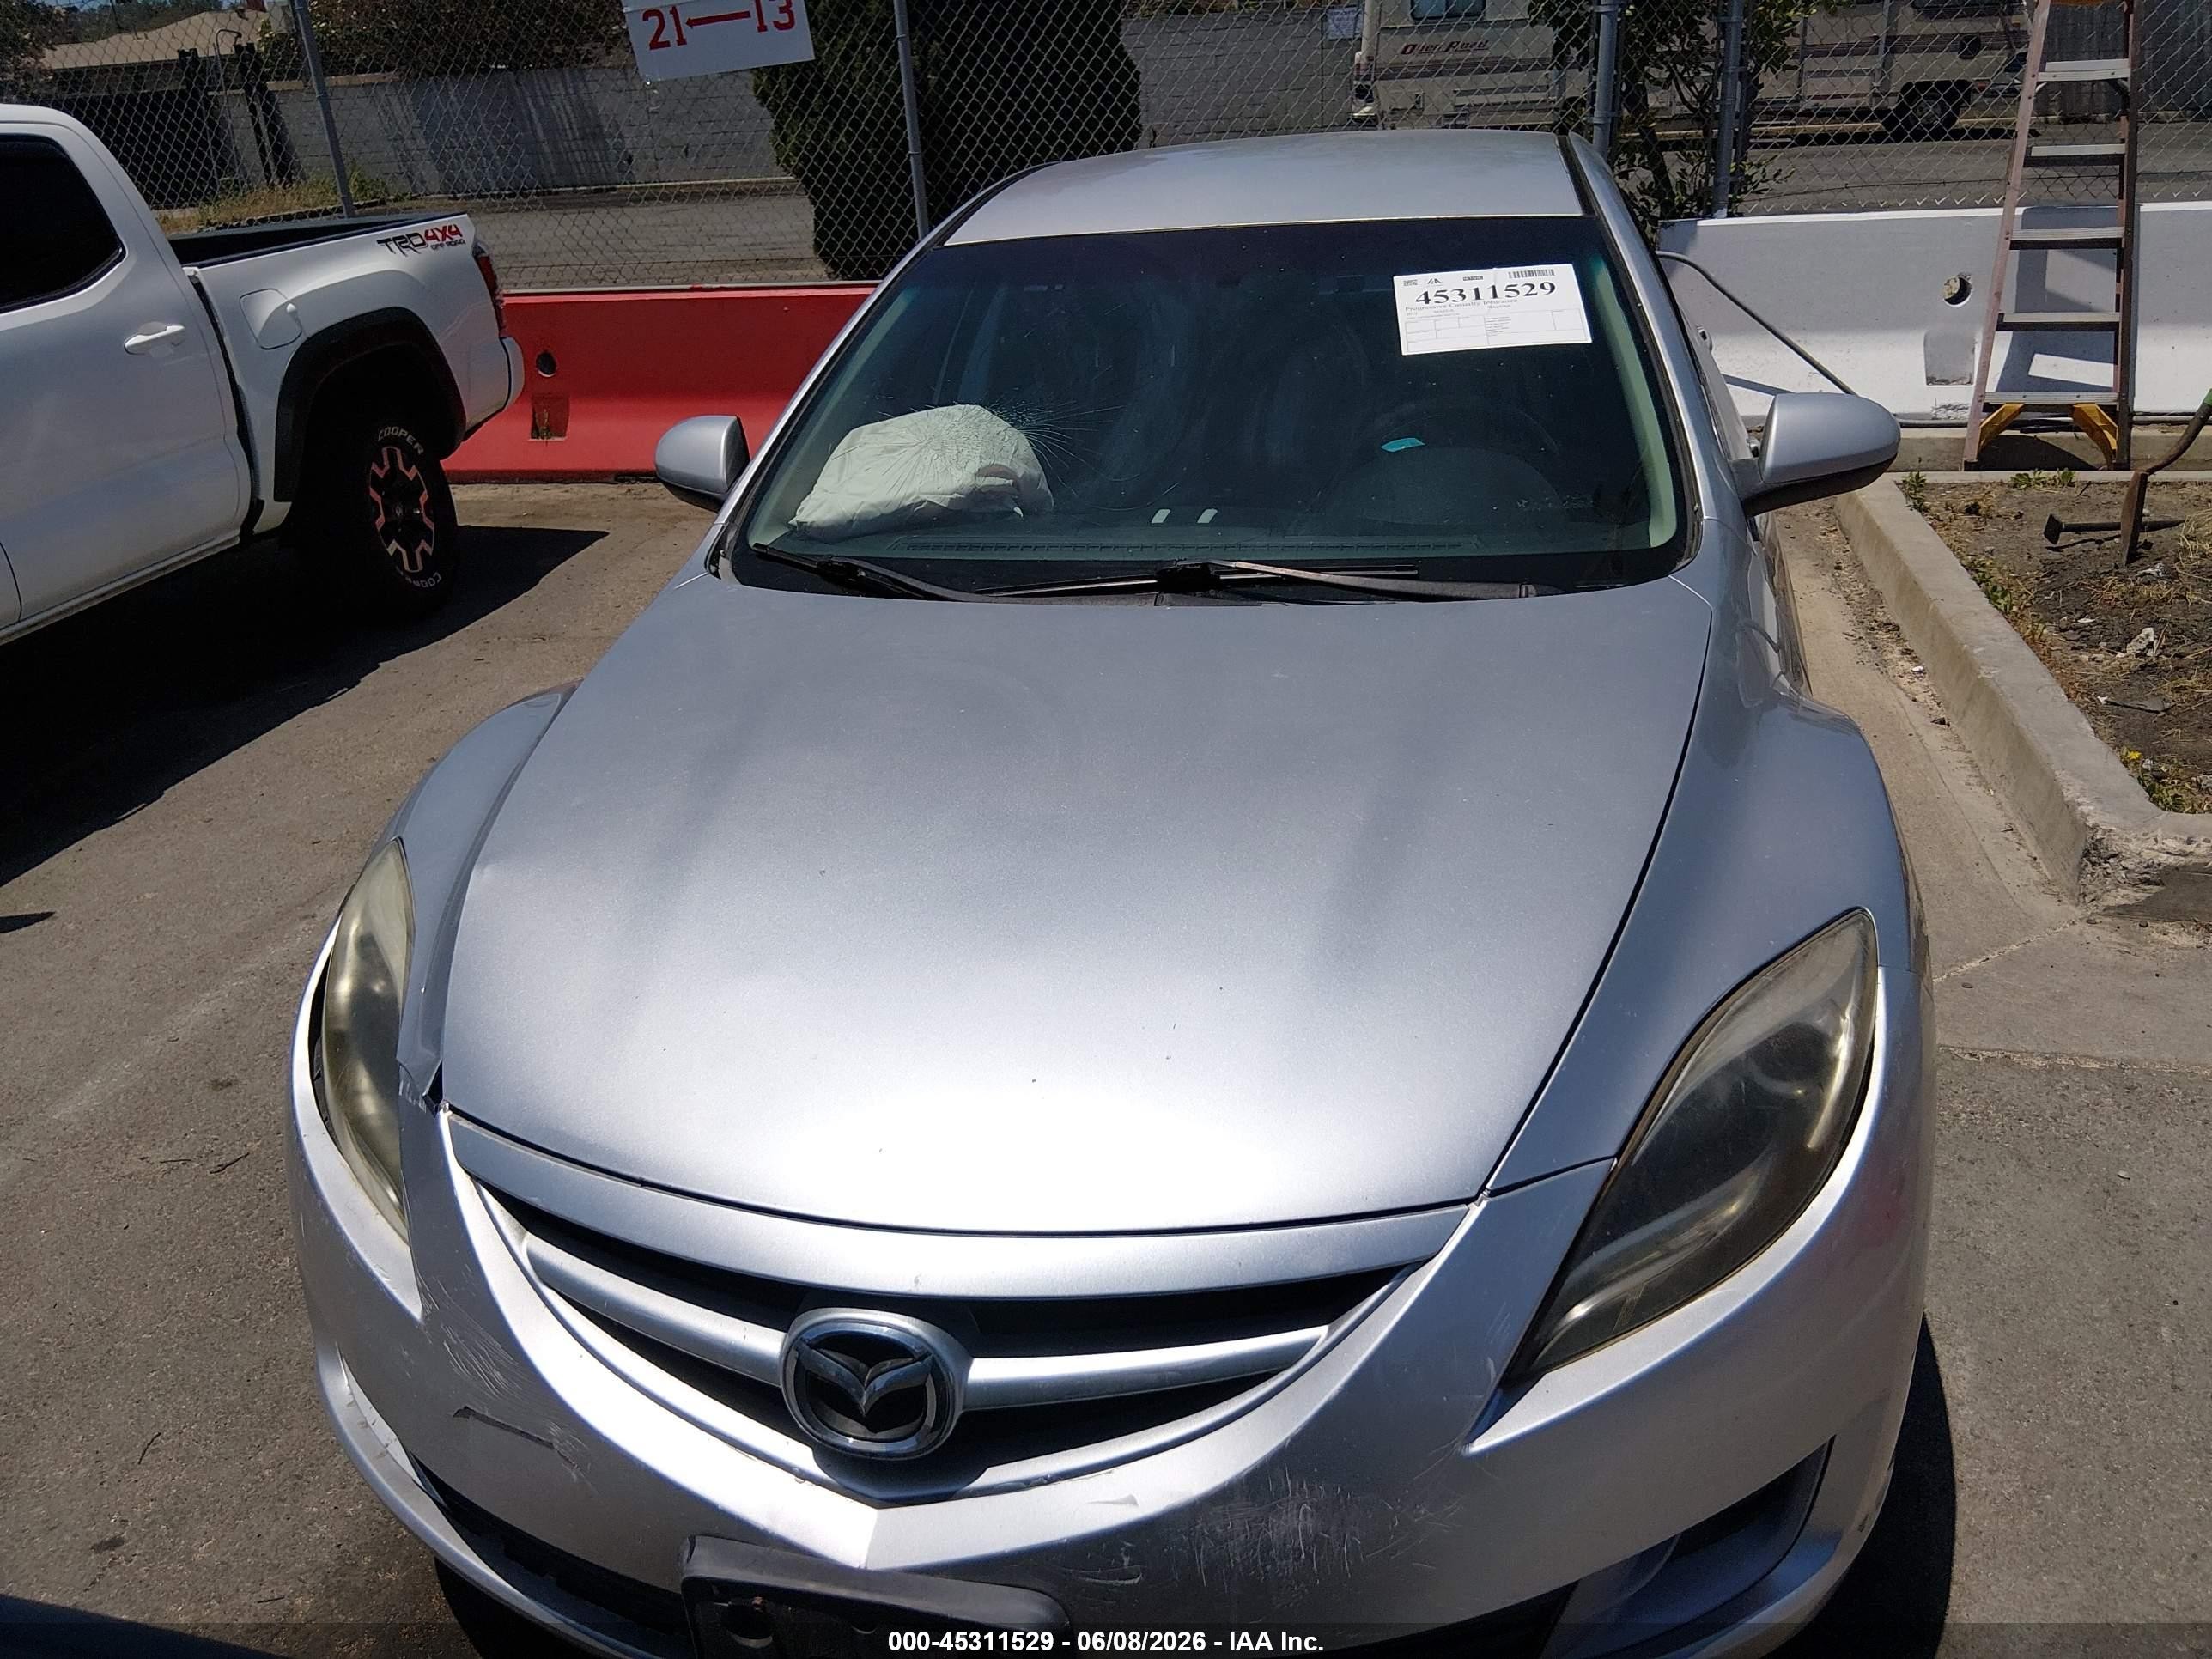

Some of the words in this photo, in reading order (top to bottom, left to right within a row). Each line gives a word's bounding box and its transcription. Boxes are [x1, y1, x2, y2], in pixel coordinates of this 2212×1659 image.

[642, 6, 687, 50] 21
[753, 0, 795, 33] 13
[376, 233, 427, 257] TRD
[1415, 281, 1556, 305] 45311529
[1405, 303, 1447, 312] Progressive
[378, 427, 424, 455] COOPER
